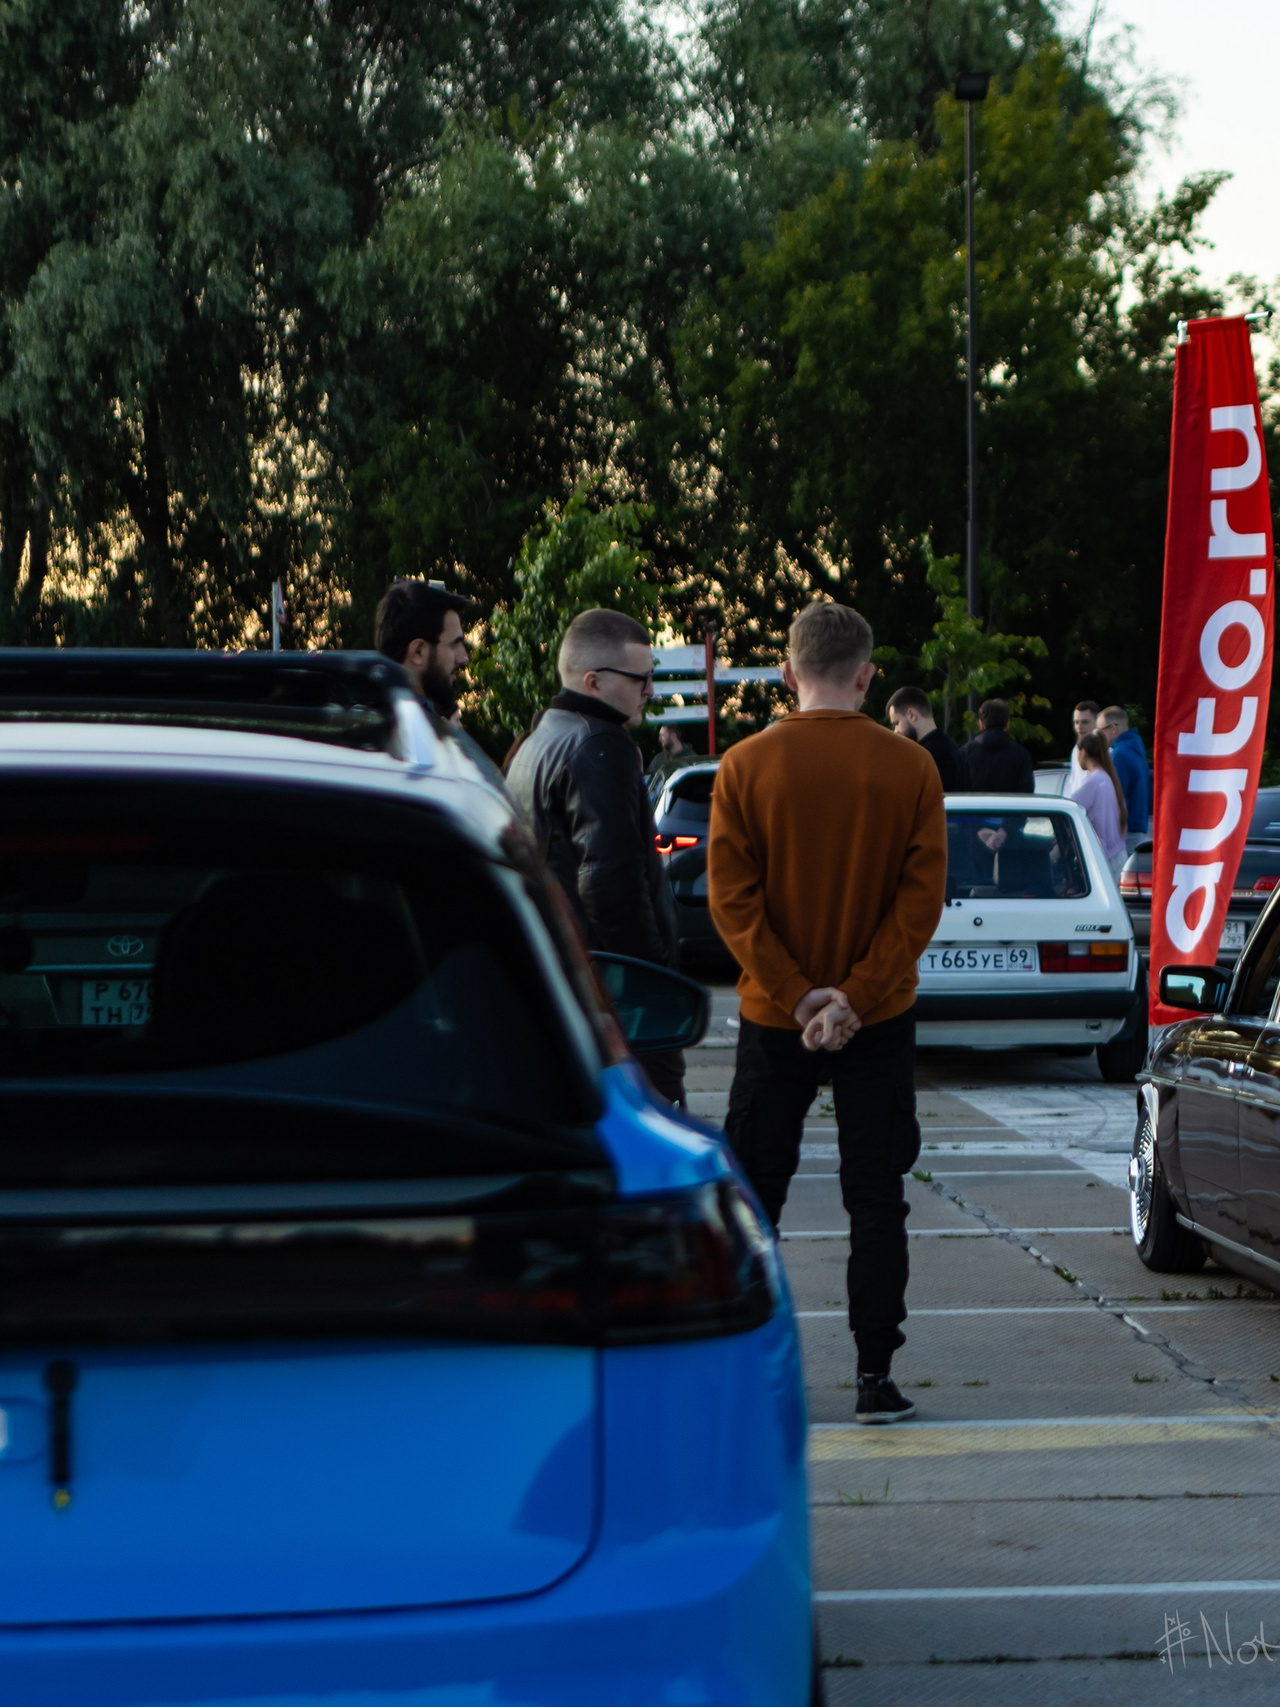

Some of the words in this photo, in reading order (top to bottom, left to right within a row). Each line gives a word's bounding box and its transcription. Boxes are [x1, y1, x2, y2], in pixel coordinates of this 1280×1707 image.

[1165, 403, 1267, 954] auto.ru
[927, 950, 1004, 969] Т665УЕ
[1009, 949, 1028, 963] 69
